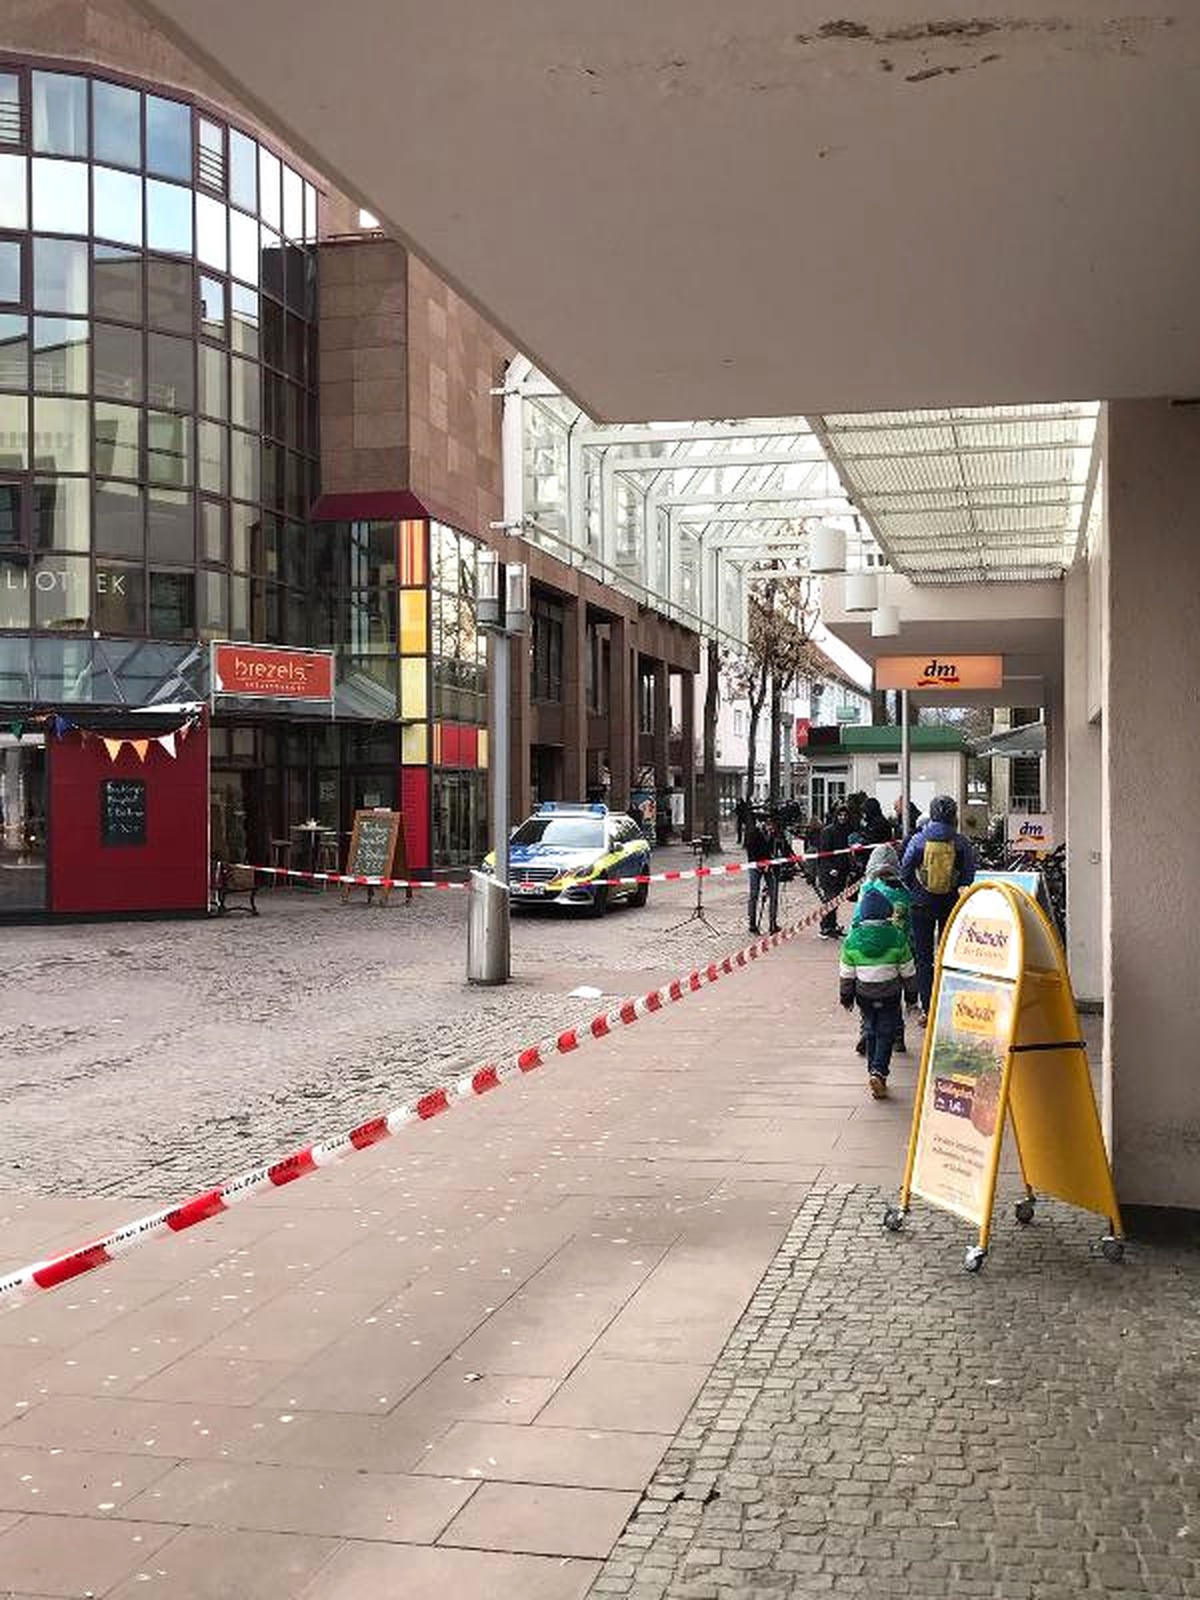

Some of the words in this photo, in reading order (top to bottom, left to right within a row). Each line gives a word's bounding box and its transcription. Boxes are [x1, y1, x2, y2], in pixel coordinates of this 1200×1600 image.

[6, 569, 126, 596] LIOTEK
[923, 659, 957, 677] dm
[1019, 821, 1043, 836] dm
